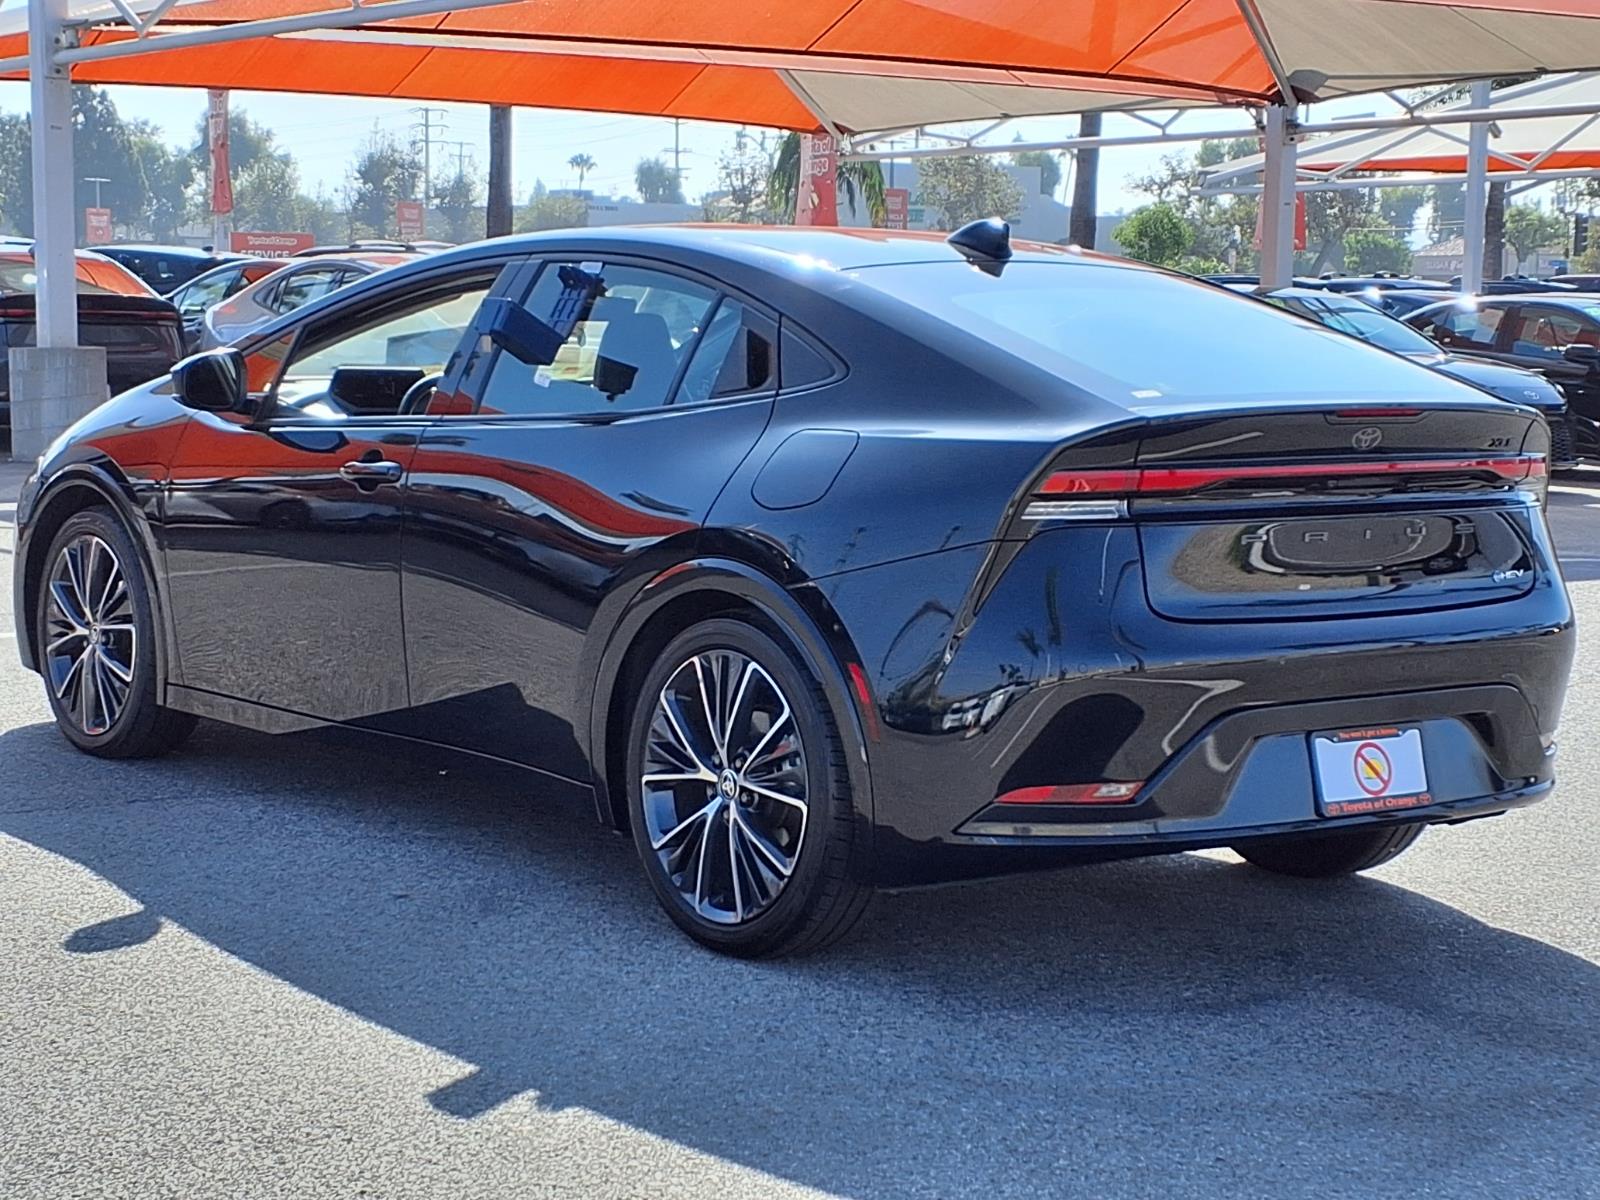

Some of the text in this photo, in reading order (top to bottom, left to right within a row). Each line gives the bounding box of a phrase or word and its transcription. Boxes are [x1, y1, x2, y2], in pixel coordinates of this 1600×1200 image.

[1241, 523, 1475, 545] PRIUS
[1341, 797, 1418, 811] Toyota of Orange
